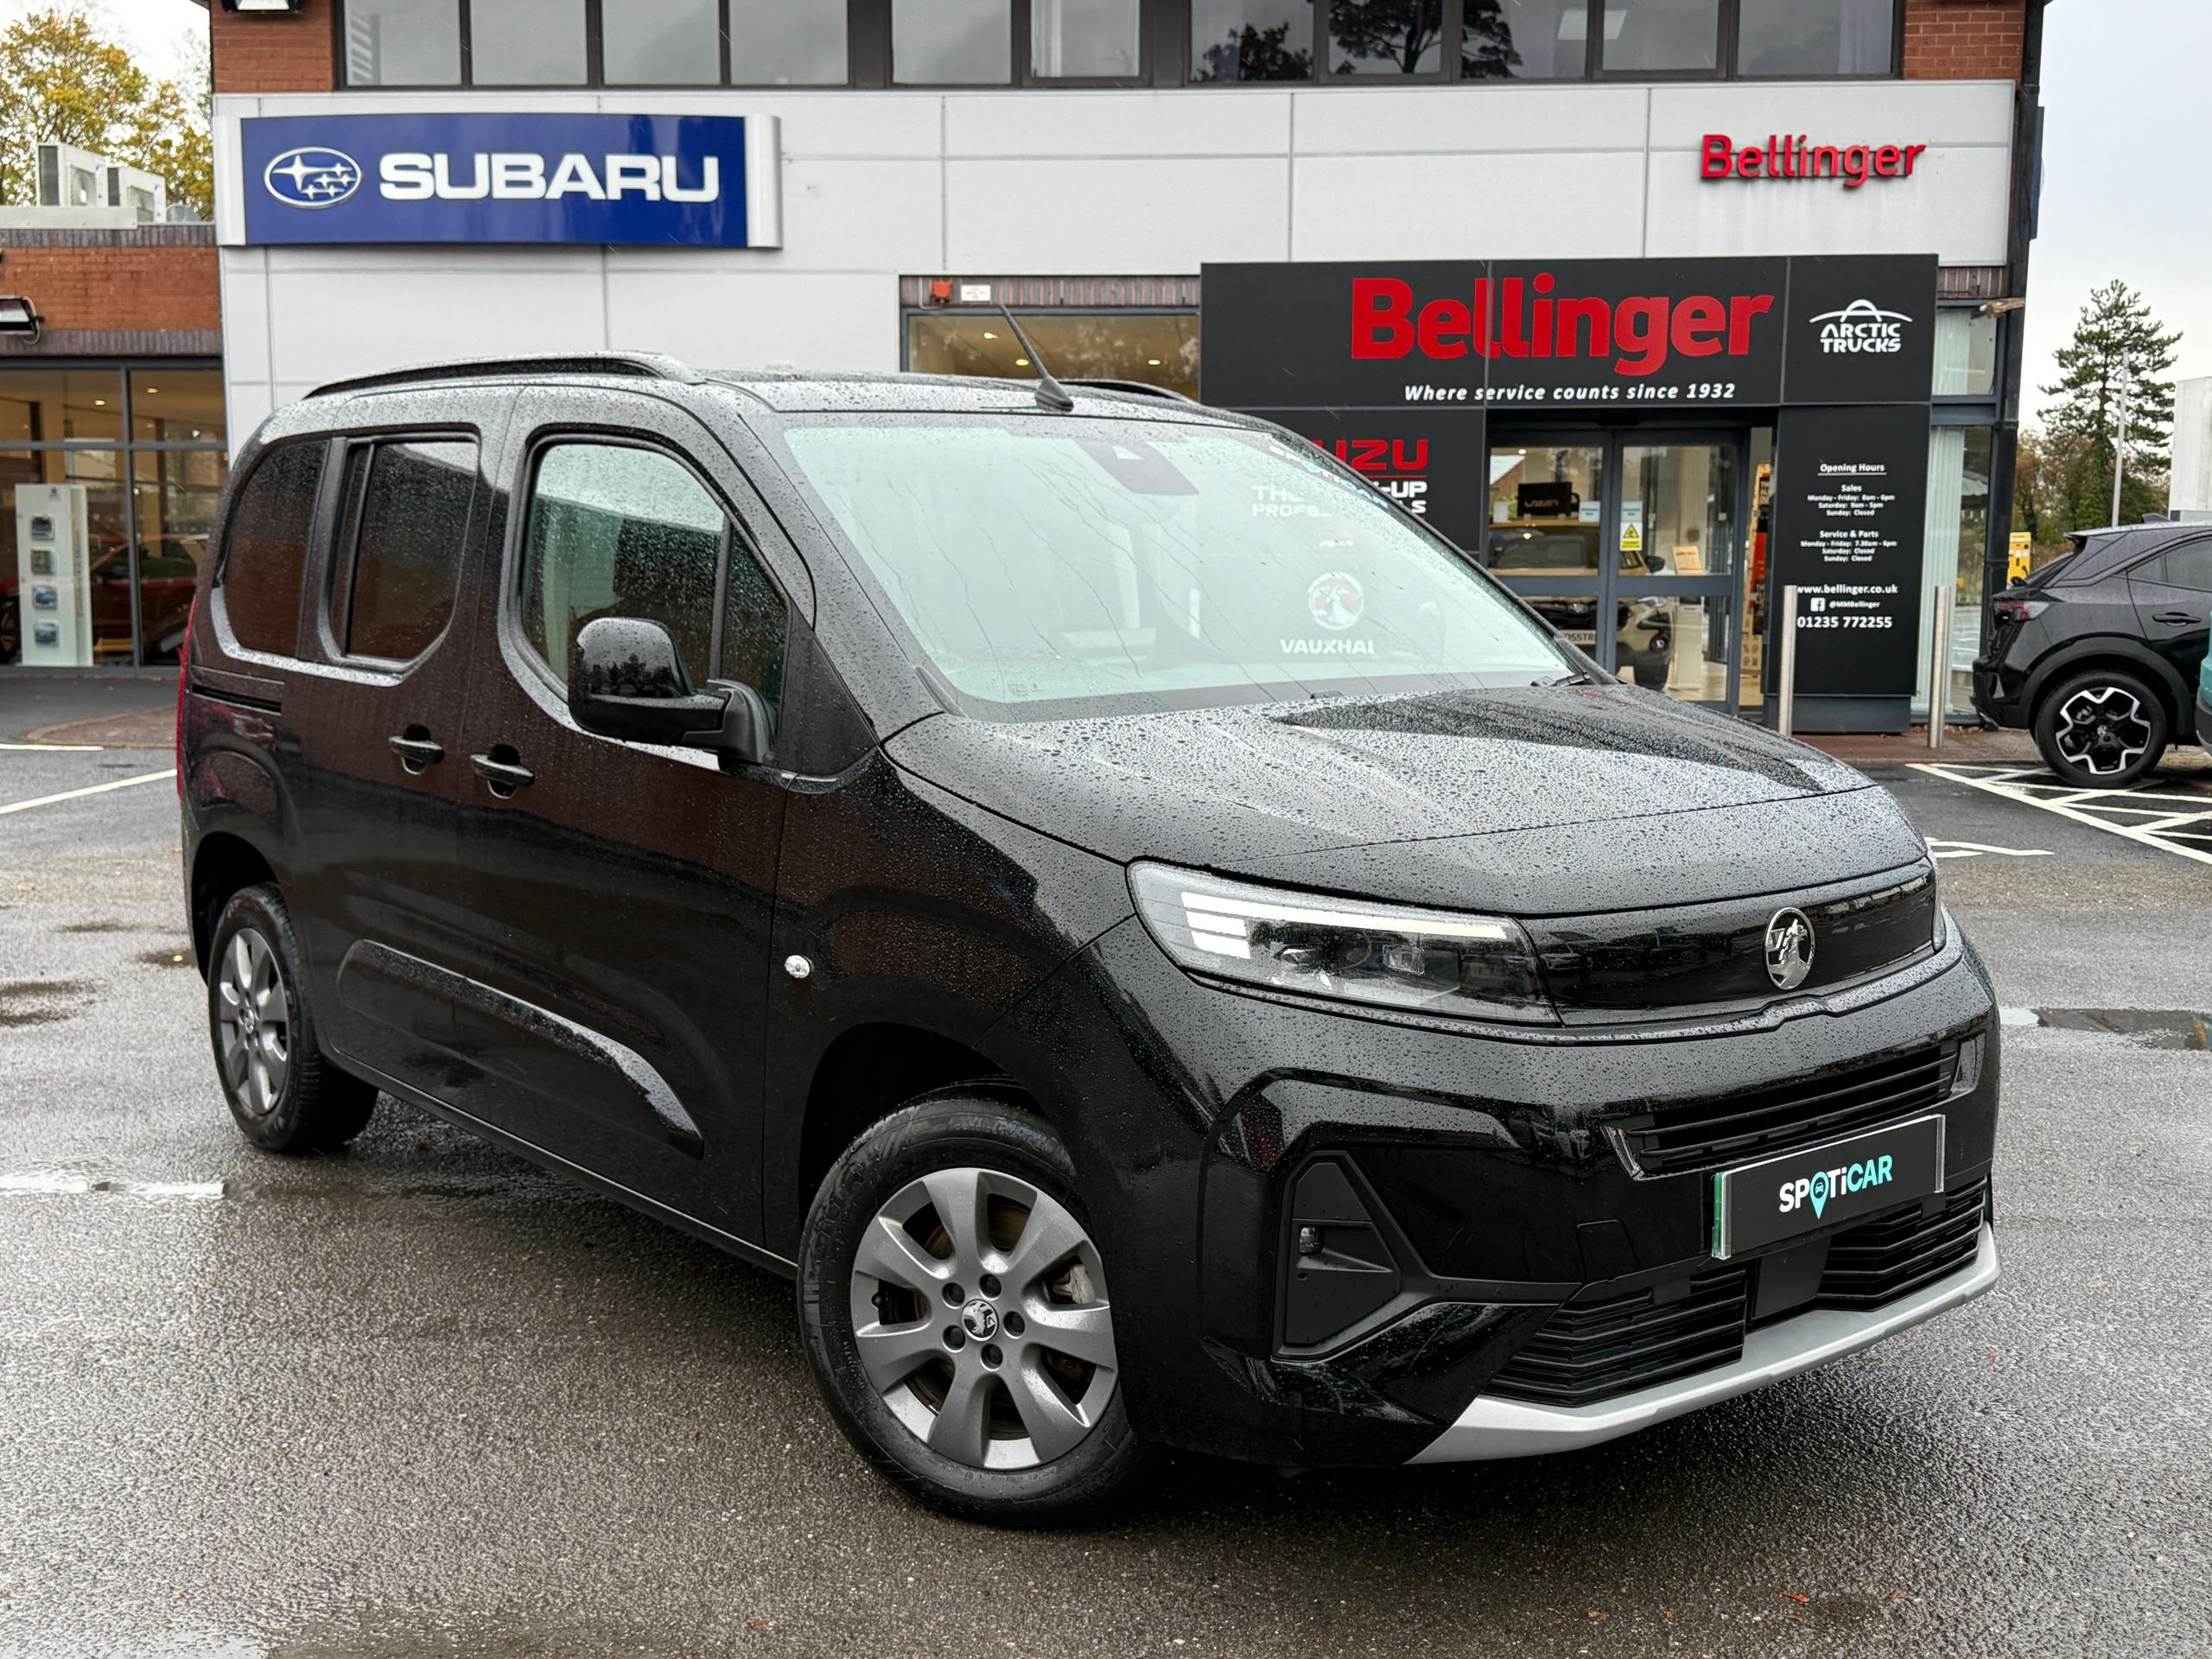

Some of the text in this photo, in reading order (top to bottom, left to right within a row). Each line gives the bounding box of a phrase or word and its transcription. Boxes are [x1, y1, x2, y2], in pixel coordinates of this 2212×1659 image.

[1700, 134, 1927, 187] Bellinger
[379, 152, 720, 202] SUBARU
[1351, 271, 1775, 377] Bellinger
[1820, 322, 1902, 338] ARCTIC
[1820, 338, 1902, 353] TRUCKS
[1404, 383, 1736, 402] Where service counts since 1932
[1820, 463, 1885, 474] Opening Hours
[1840, 484, 1862, 493] Sales
[1819, 530, 1879, 538] Service & Parts
[1796, 584, 1898, 595] www.bellinger.co.uk
[1796, 616, 1893, 628] 01235 772255
